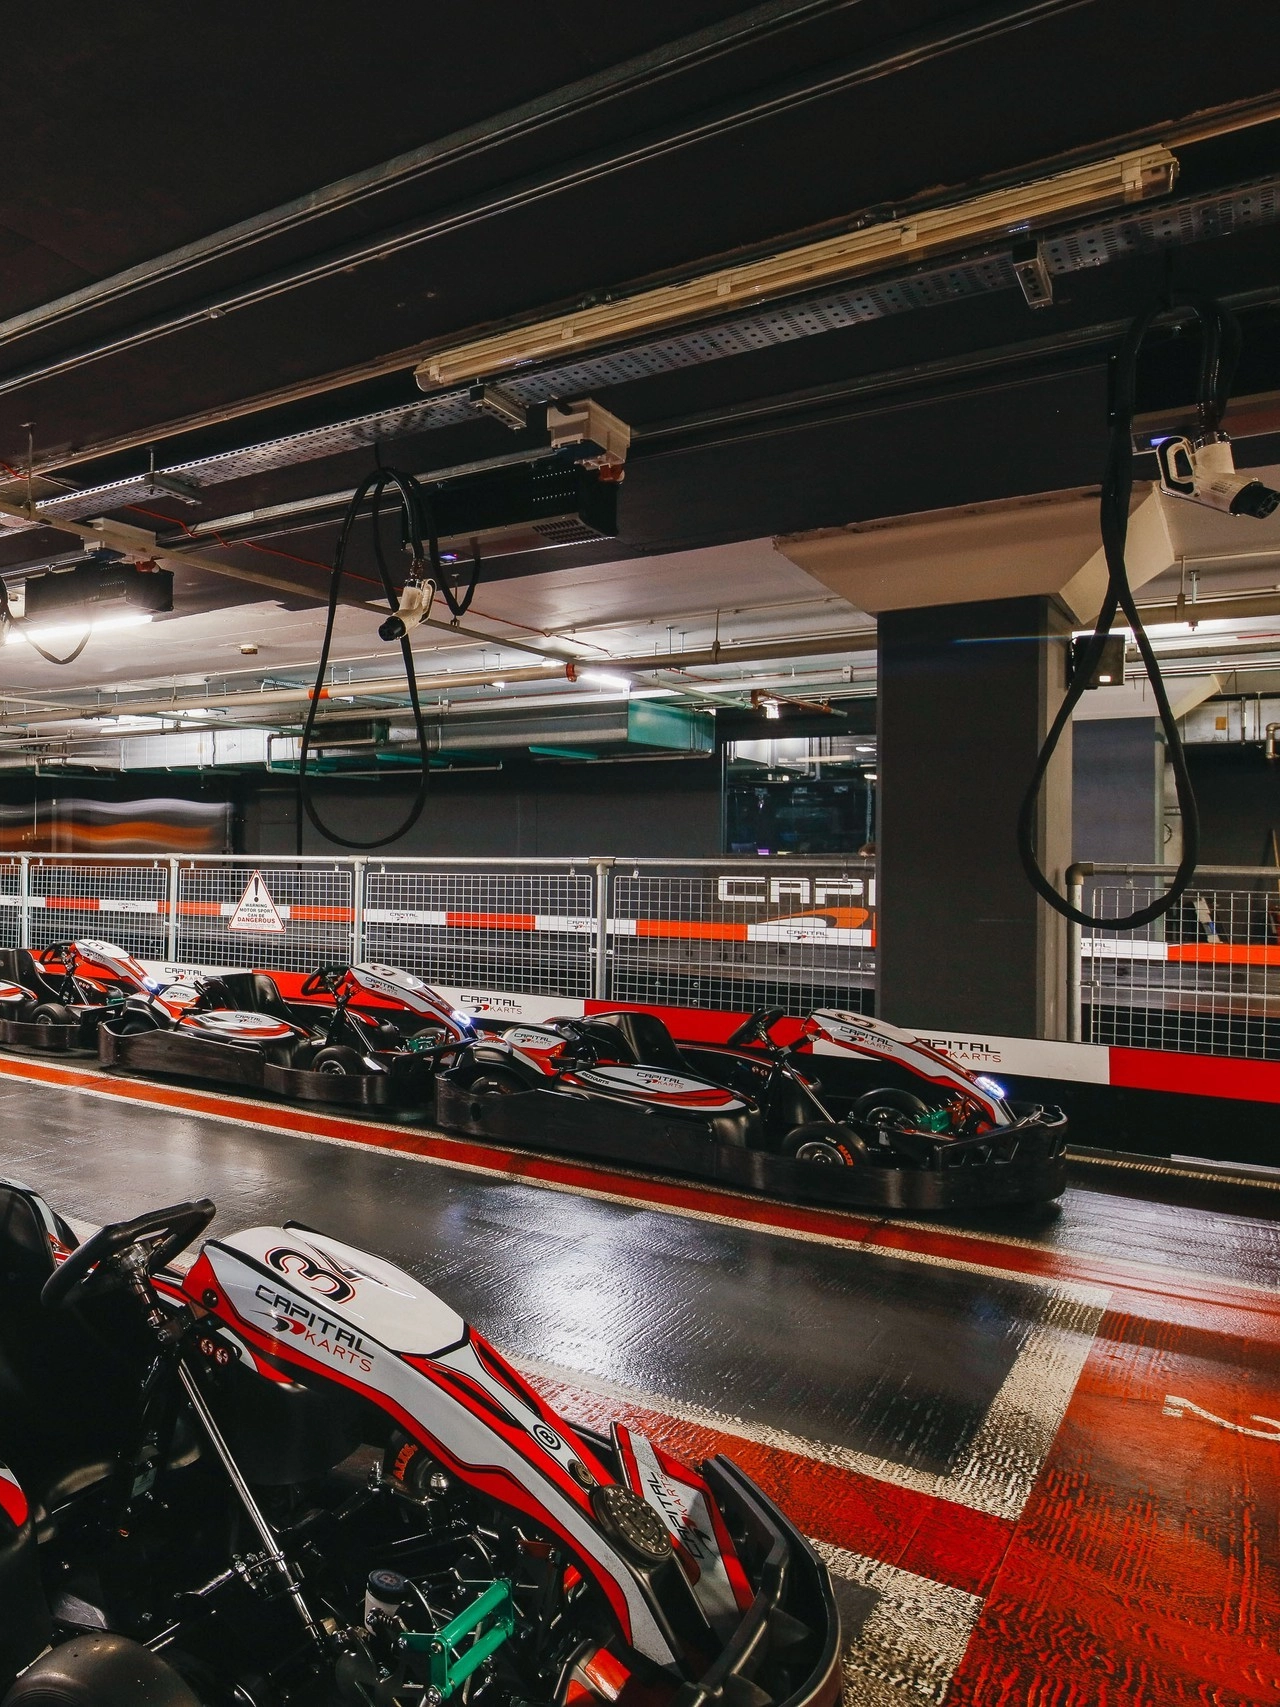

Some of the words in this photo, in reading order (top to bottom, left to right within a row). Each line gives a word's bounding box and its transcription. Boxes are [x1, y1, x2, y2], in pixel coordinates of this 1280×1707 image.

[164, 967, 207, 977] CAPITAL
[365, 976, 398, 992] CAPITAL
[460, 994, 522, 1008] CAPITAL
[489, 1006, 522, 1015] KARTS
[514, 1032, 552, 1043] CAPITAL
[840, 1026, 893, 1047] CAPITAL
[864, 1040, 894, 1052] KARTS
[919, 1038, 1001, 1054] APITAL
[949, 1051, 1002, 1063] KARTS
[581, 1072, 610, 1085] BIZKARTS
[636, 1072, 684, 1086] CAPITAL
[658, 1081, 683, 1089] KARTS
[255, 1284, 375, 1359] CAPITAL
[304, 1330, 373, 1372] KARTS
[660, 1473, 688, 1516] KARTS
[646, 1471, 705, 1560] CAPITAL
